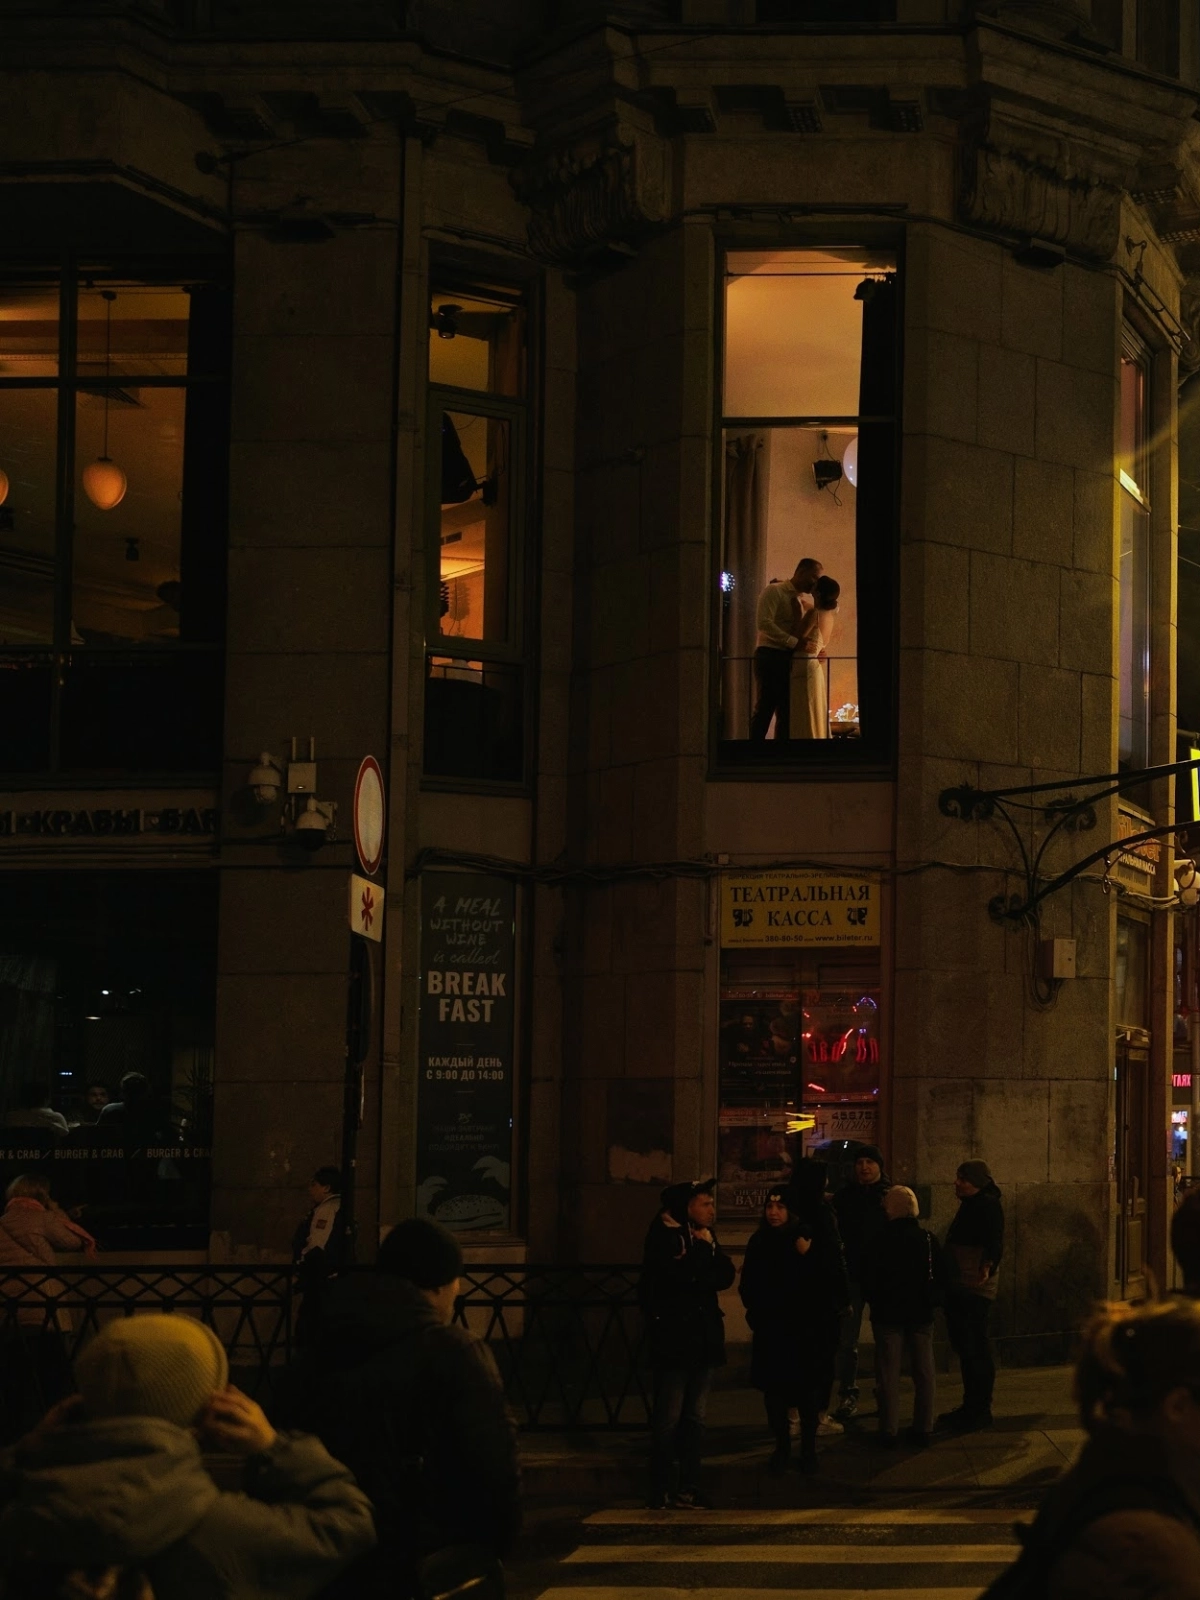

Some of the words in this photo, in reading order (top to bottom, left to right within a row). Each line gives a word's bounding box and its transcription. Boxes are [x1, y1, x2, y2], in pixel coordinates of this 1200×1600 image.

[34, 809, 145, 835] КРАБЫ
[730, 885, 870, 902] ТЕАТРАЛЬНАЯ
[433, 896, 447, 915] A
[455, 897, 502, 916] MEAL
[430, 918, 504, 933] WITHOUT
[767, 910, 832, 926] КАССА
[446, 933, 487, 945] WINE
[815, 934, 873, 942] www.bileter.ru
[433, 951, 445, 963] is
[450, 948, 500, 965] called
[427, 970, 507, 997] BREAK
[439, 999, 495, 1023] FAST
[428, 1056, 474, 1068] КАЖДЫЙ
[477, 1057, 503, 1069] ДЕНЬ
[436, 1070, 458, 1080] 9:00
[461, 1070, 475, 1081] ДО
[478, 1070, 504, 1080] 14:00
[1172, 1074, 1191, 1087] ГЛЯХ
[17, 1150, 40, 1159] CRAB
[54, 1149, 89, 1159] BURGER
[101, 1149, 124, 1159] CRAB
[146, 1148, 181, 1158] BURGER
[193, 1149, 213, 1158] CRA
